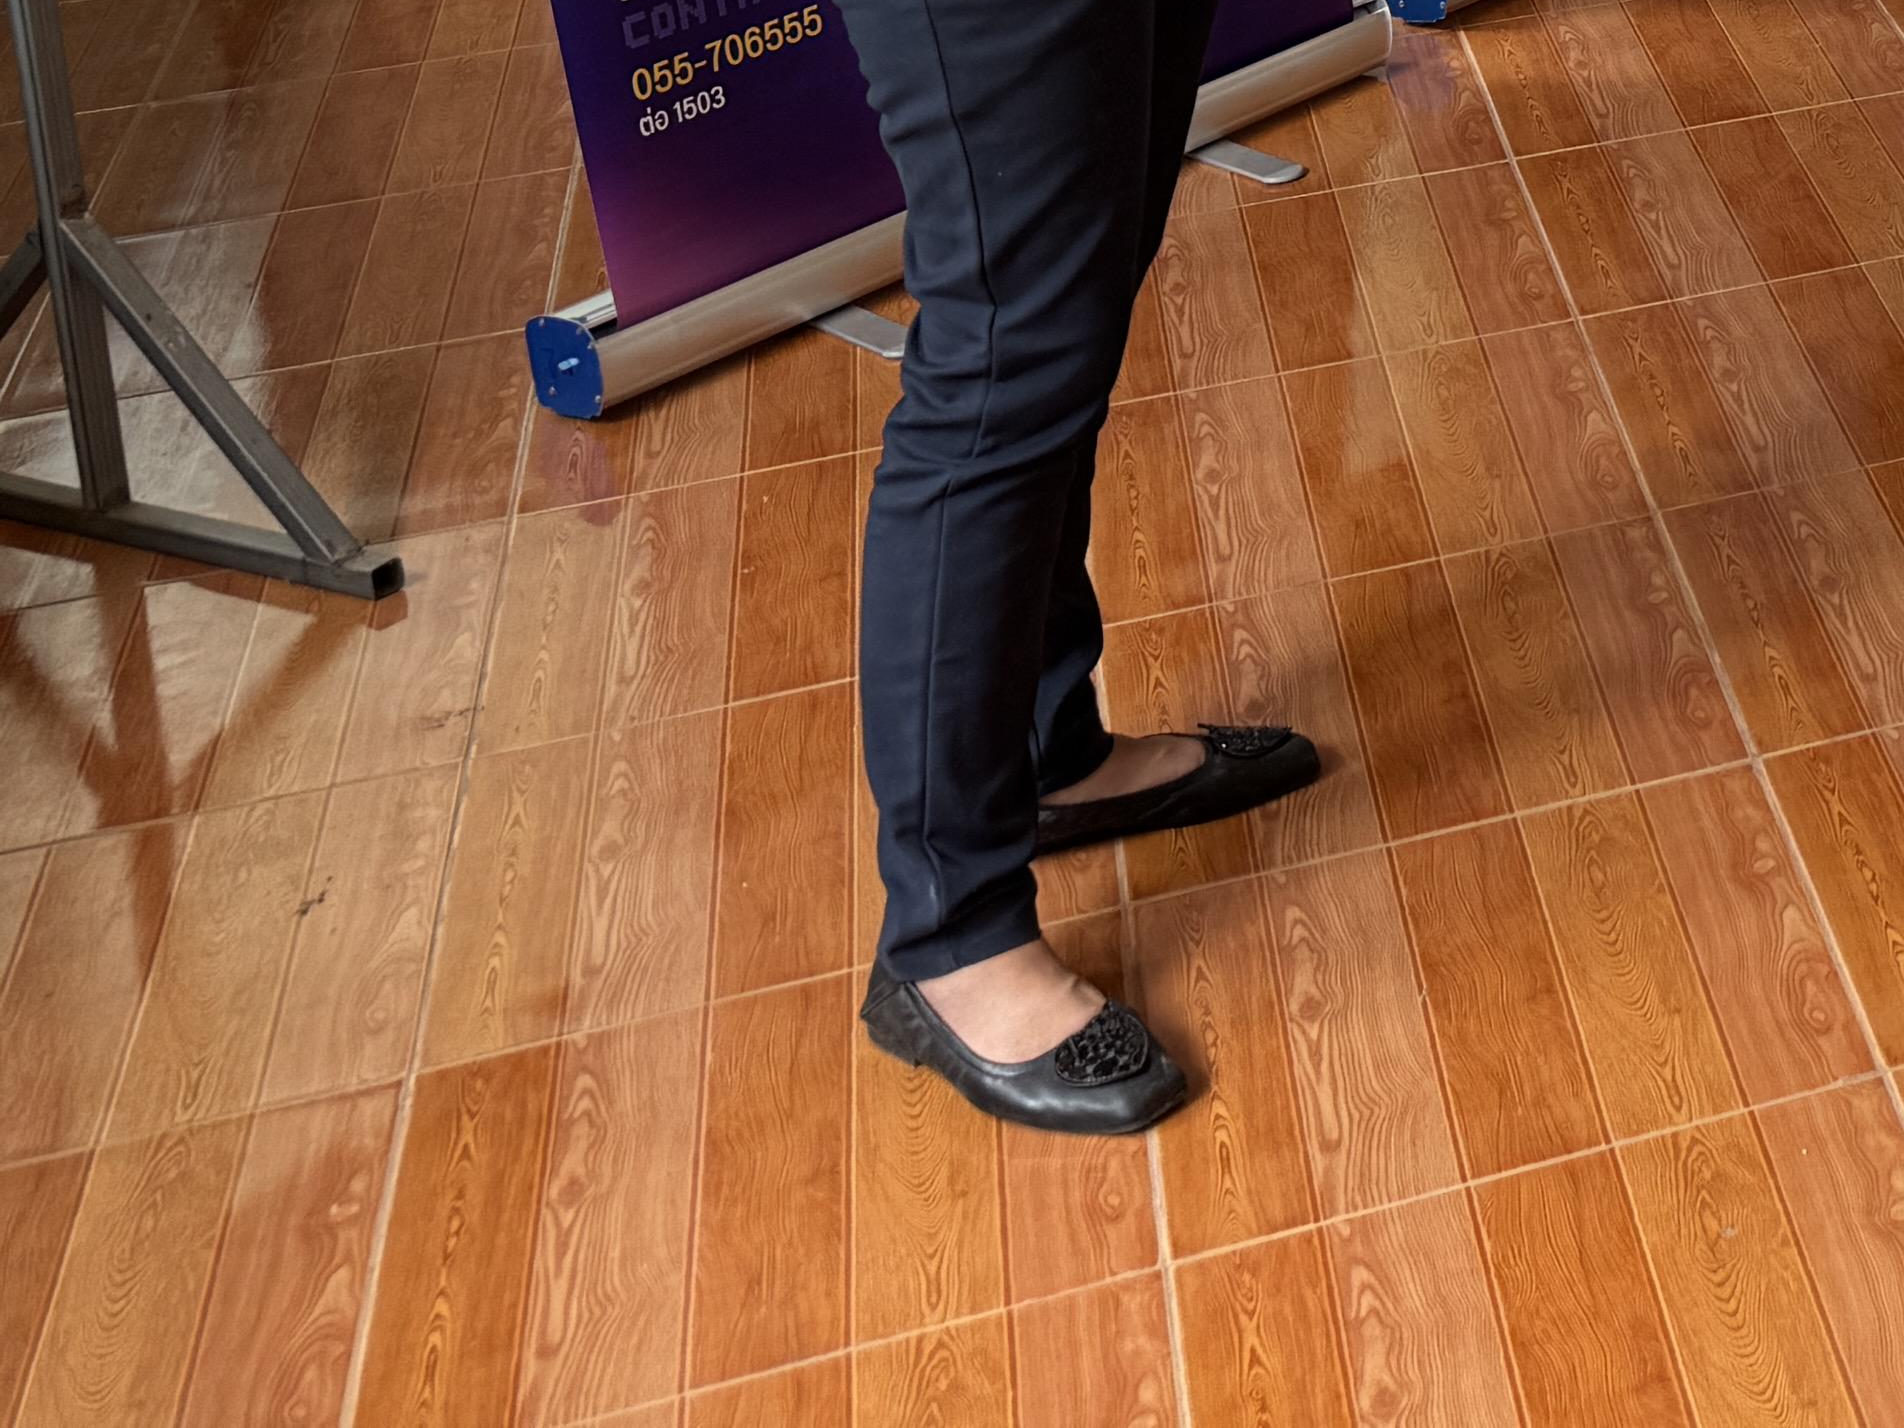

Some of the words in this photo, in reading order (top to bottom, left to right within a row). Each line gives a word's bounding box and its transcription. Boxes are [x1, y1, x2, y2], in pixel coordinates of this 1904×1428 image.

[632, 4, 823, 101] 055-706555
[639, 107, 669, 137] ต่อ
[673, 85, 726, 123] 1503
